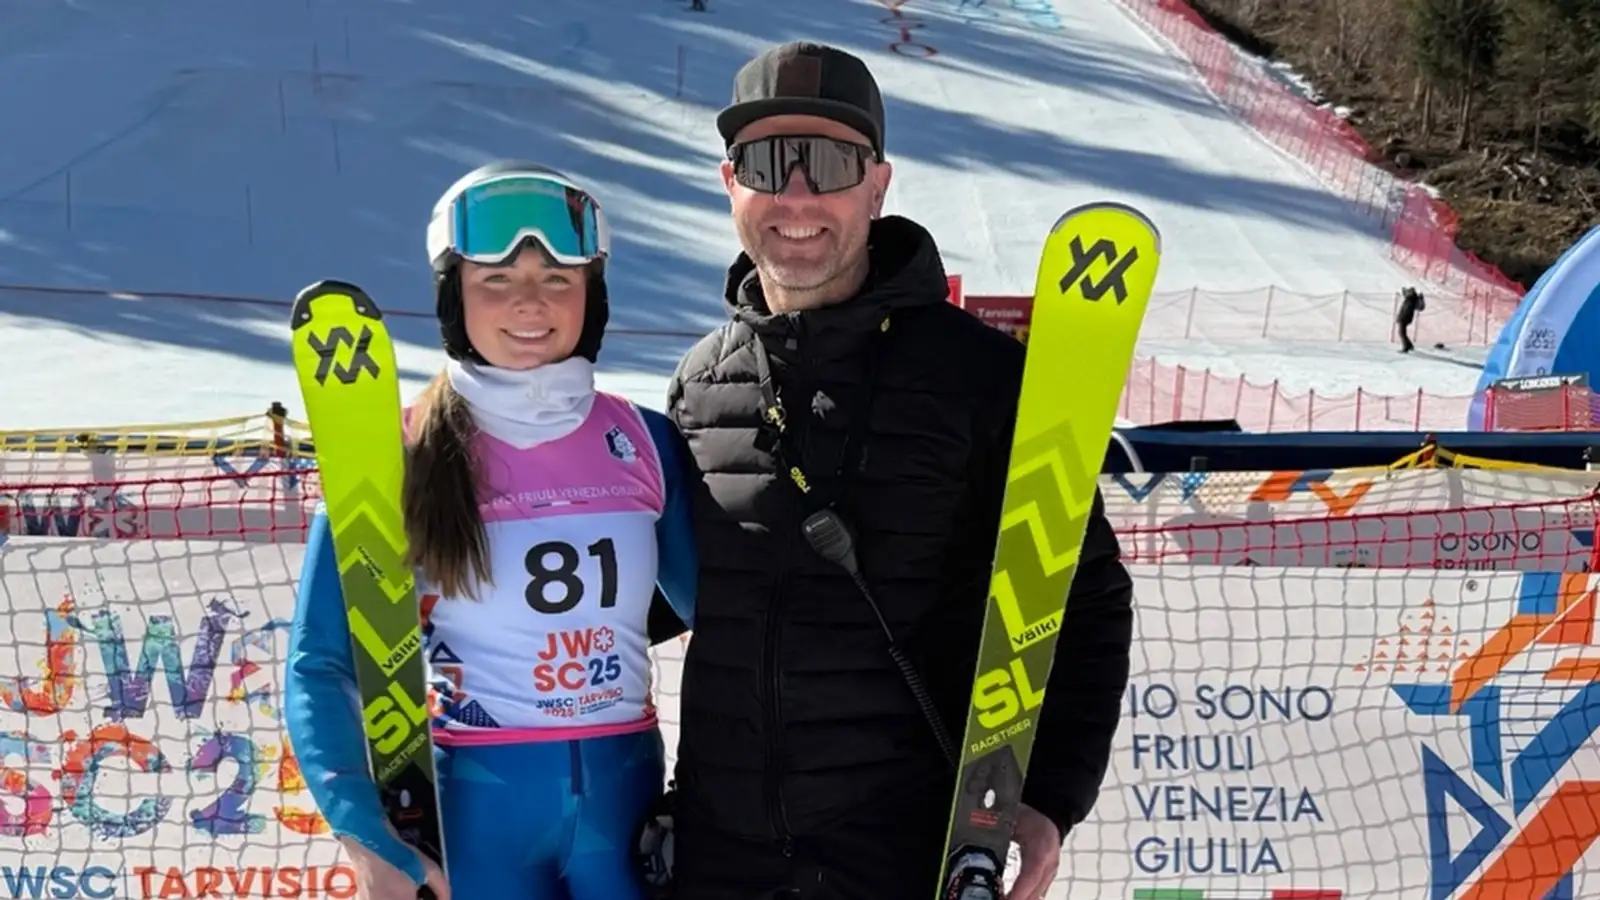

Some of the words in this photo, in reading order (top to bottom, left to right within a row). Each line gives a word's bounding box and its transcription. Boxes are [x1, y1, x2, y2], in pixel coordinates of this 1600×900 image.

[1467, 532, 1541, 552] SONO
[524, 537, 618, 614] 81
[533, 654, 621, 692] SC25
[536, 697, 574, 708] JWSC
[974, 657, 1045, 729] SL
[1129, 684, 1177, 719] IO
[1195, 685, 1333, 721] SONO
[363, 680, 427, 754] SL
[971, 718, 1031, 754] RACETIGER
[1132, 734, 1254, 771] FRIULI
[1132, 785, 1324, 822] VENEZIA
[1135, 836, 1283, 873] GIULIA
[133, 866, 358, 900] TARVISIO
